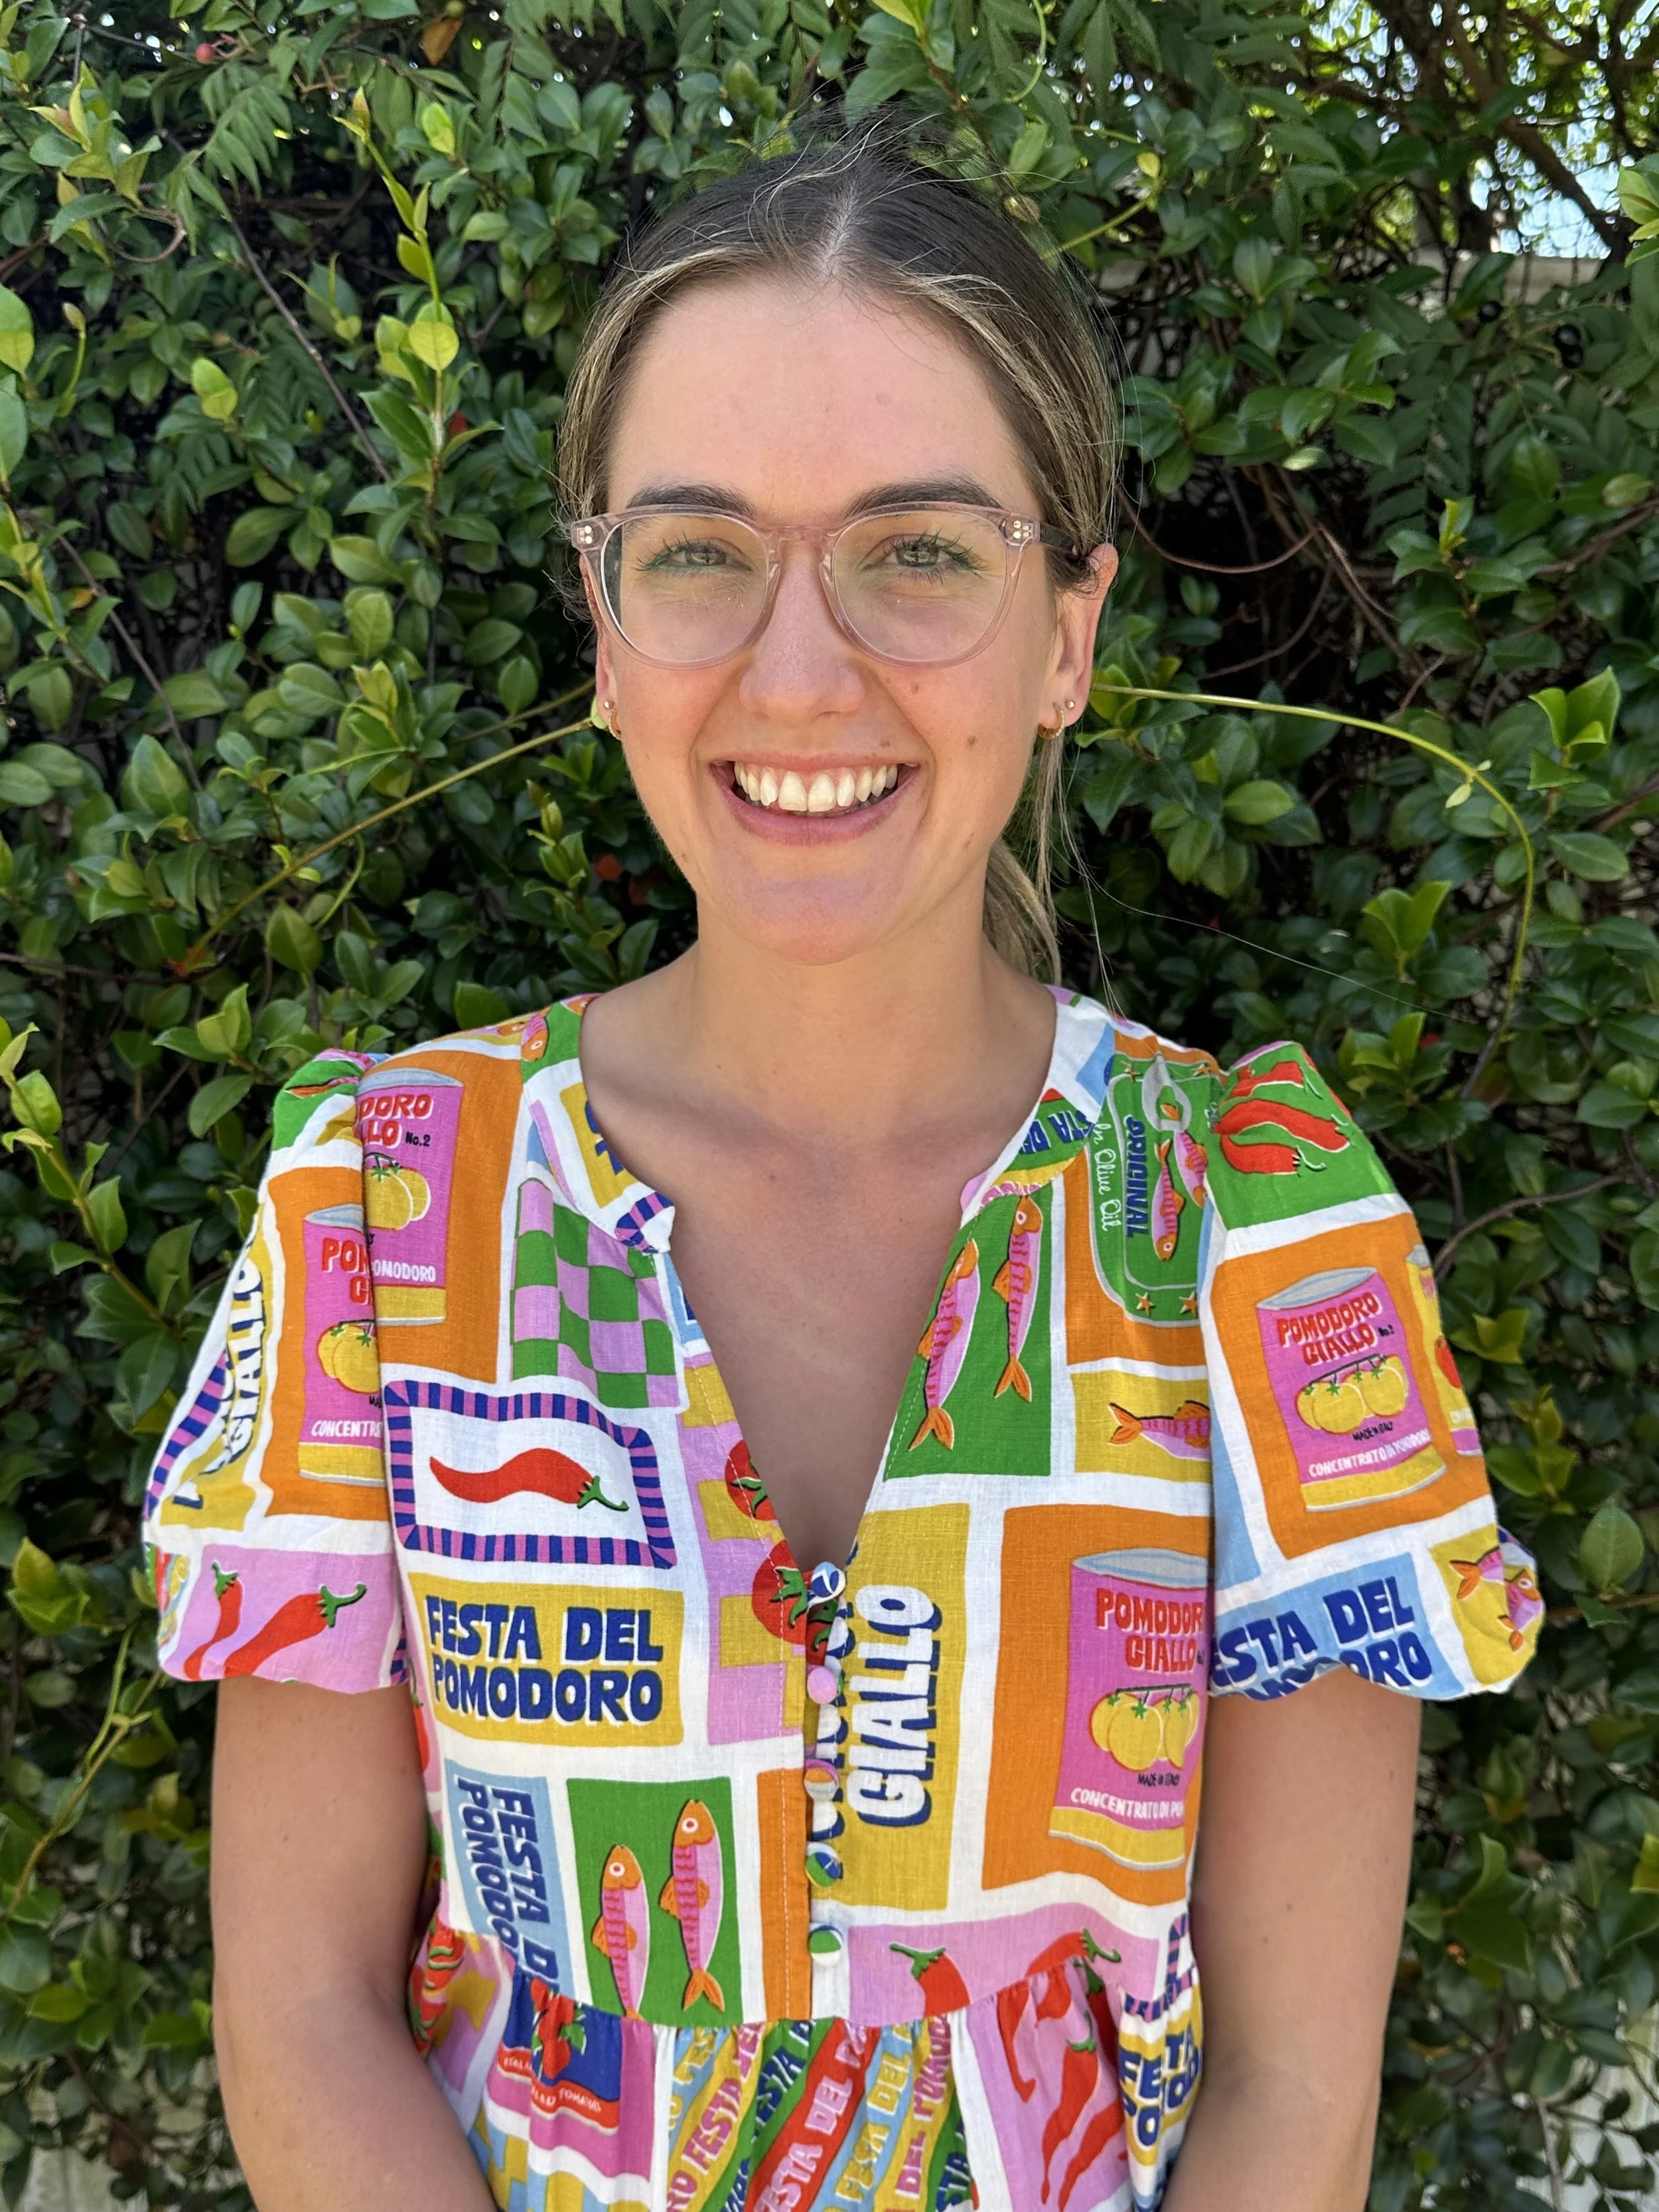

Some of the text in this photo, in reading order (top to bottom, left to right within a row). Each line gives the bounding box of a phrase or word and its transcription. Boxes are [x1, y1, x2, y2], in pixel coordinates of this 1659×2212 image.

[405, 1131, 431, 1147] No.2
[1094, 1148, 1116, 1195] Olive
[1123, 1114, 1149, 1238] ORIGINAL
[1099, 1199, 1122, 1232] Oil
[372, 1258, 437, 1283] OMODORO
[1275, 1291, 1383, 1349] POMODORO
[1302, 1322, 1379, 1366] GIALLO
[1308, 1446, 1388, 1478] CONCENTRATO
[425, 1594, 664, 1666] FESTA DEL
[1096, 1587, 1206, 1637] POMODOR
[1323, 1576, 1415, 1649] DEL
[1125, 1635, 1198, 1675] GIALLO
[431, 1652, 663, 1727] POMODORO
[845, 1584, 943, 1828] GIALLO
[1070, 1787, 1159, 1820] CONCENTRATO
[454, 1773, 520, 1958] POMODO
[488, 1785, 551, 1924] FESTA
[804, 2075, 854, 2136] DEL
[865, 2050, 911, 2116] DEL
[681, 2077, 743, 2175] FESTA
[894, 2129, 927, 2200] DEL
